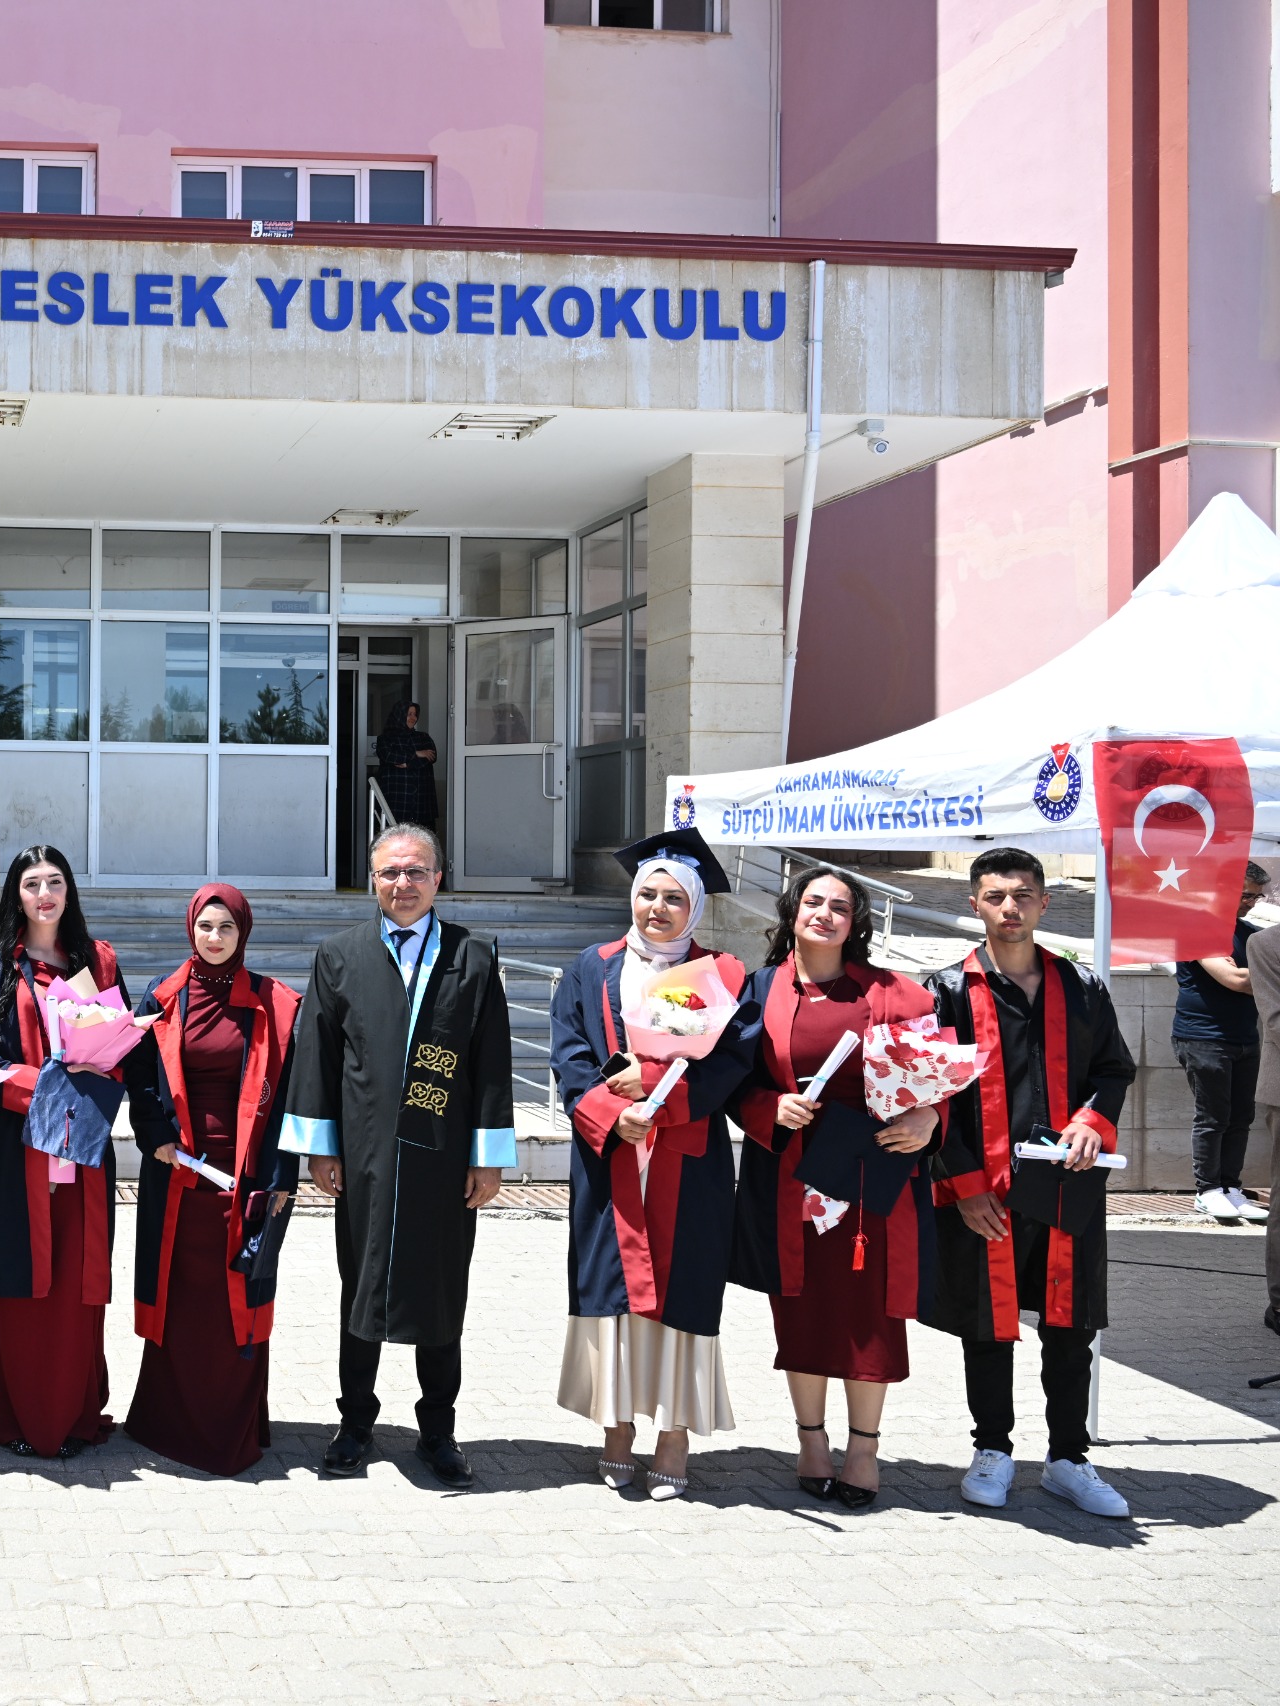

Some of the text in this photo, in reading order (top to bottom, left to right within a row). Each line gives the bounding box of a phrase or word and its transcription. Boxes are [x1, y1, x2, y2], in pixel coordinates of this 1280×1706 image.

[255, 268, 787, 342] YÜKSEKOKULU
[775, 768, 906, 794] KAHRAMANMARAŞ
[721, 801, 774, 841] SÜTÇÜ
[777, 799, 826, 833] İMAM
[829, 784, 985, 832] ÜNİVERSİTESİ
[926, 1057, 939, 1074] Love
[883, 1094, 892, 1112] Love
